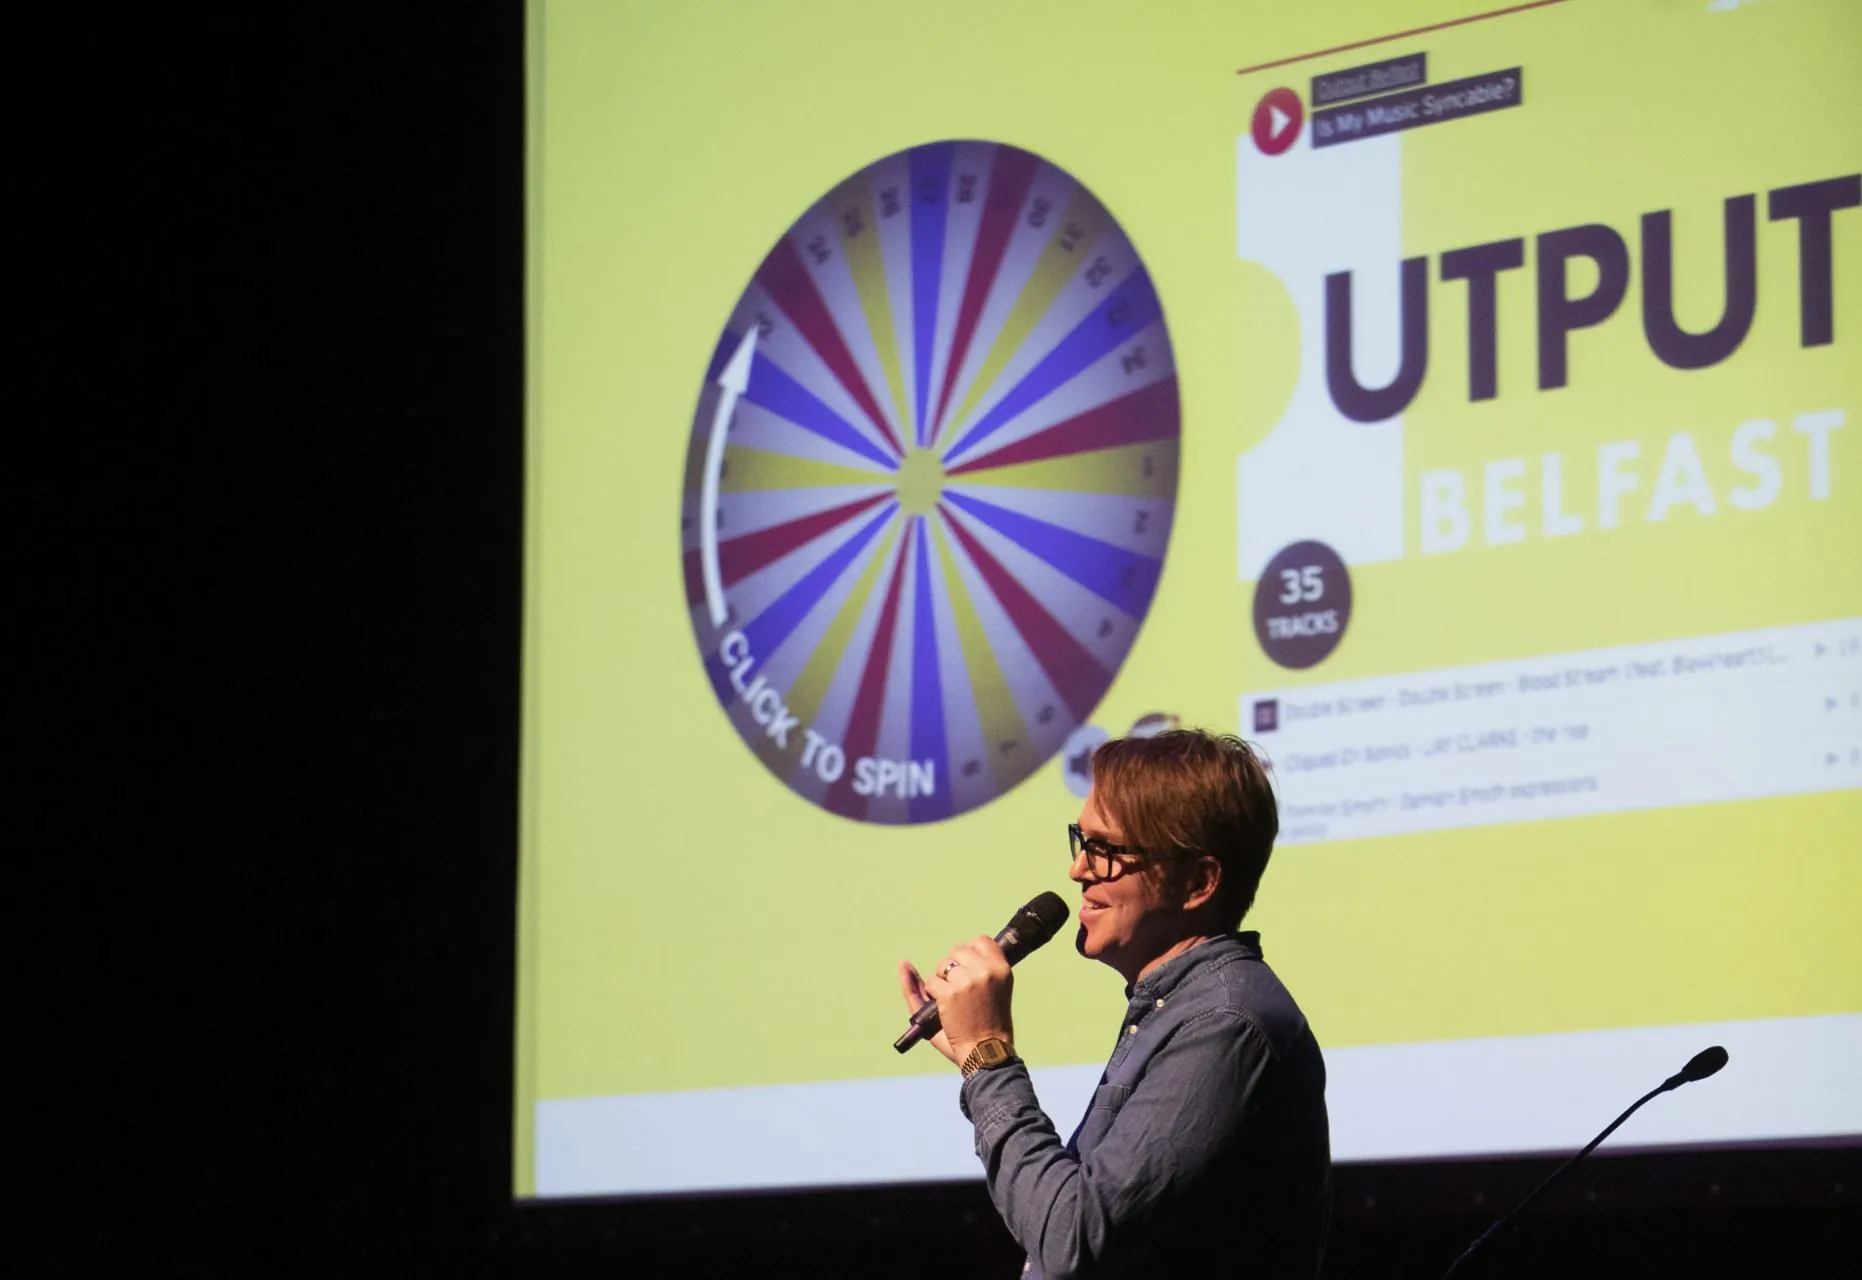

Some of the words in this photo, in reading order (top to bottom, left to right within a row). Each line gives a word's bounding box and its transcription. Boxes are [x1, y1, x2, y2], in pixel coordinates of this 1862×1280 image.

[1336, 112, 1362, 134] My
[1366, 101, 1419, 127] Music
[1421, 77, 1515, 116] Syncable?
[1420, 408, 1847, 555] BELFAST
[1279, 565, 1323, 605] 35
[1266, 610, 1338, 639] TRACKS
[719, 630, 800, 750] CLICK
[800, 729, 845, 783] TO
[851, 757, 936, 799] SPIN
